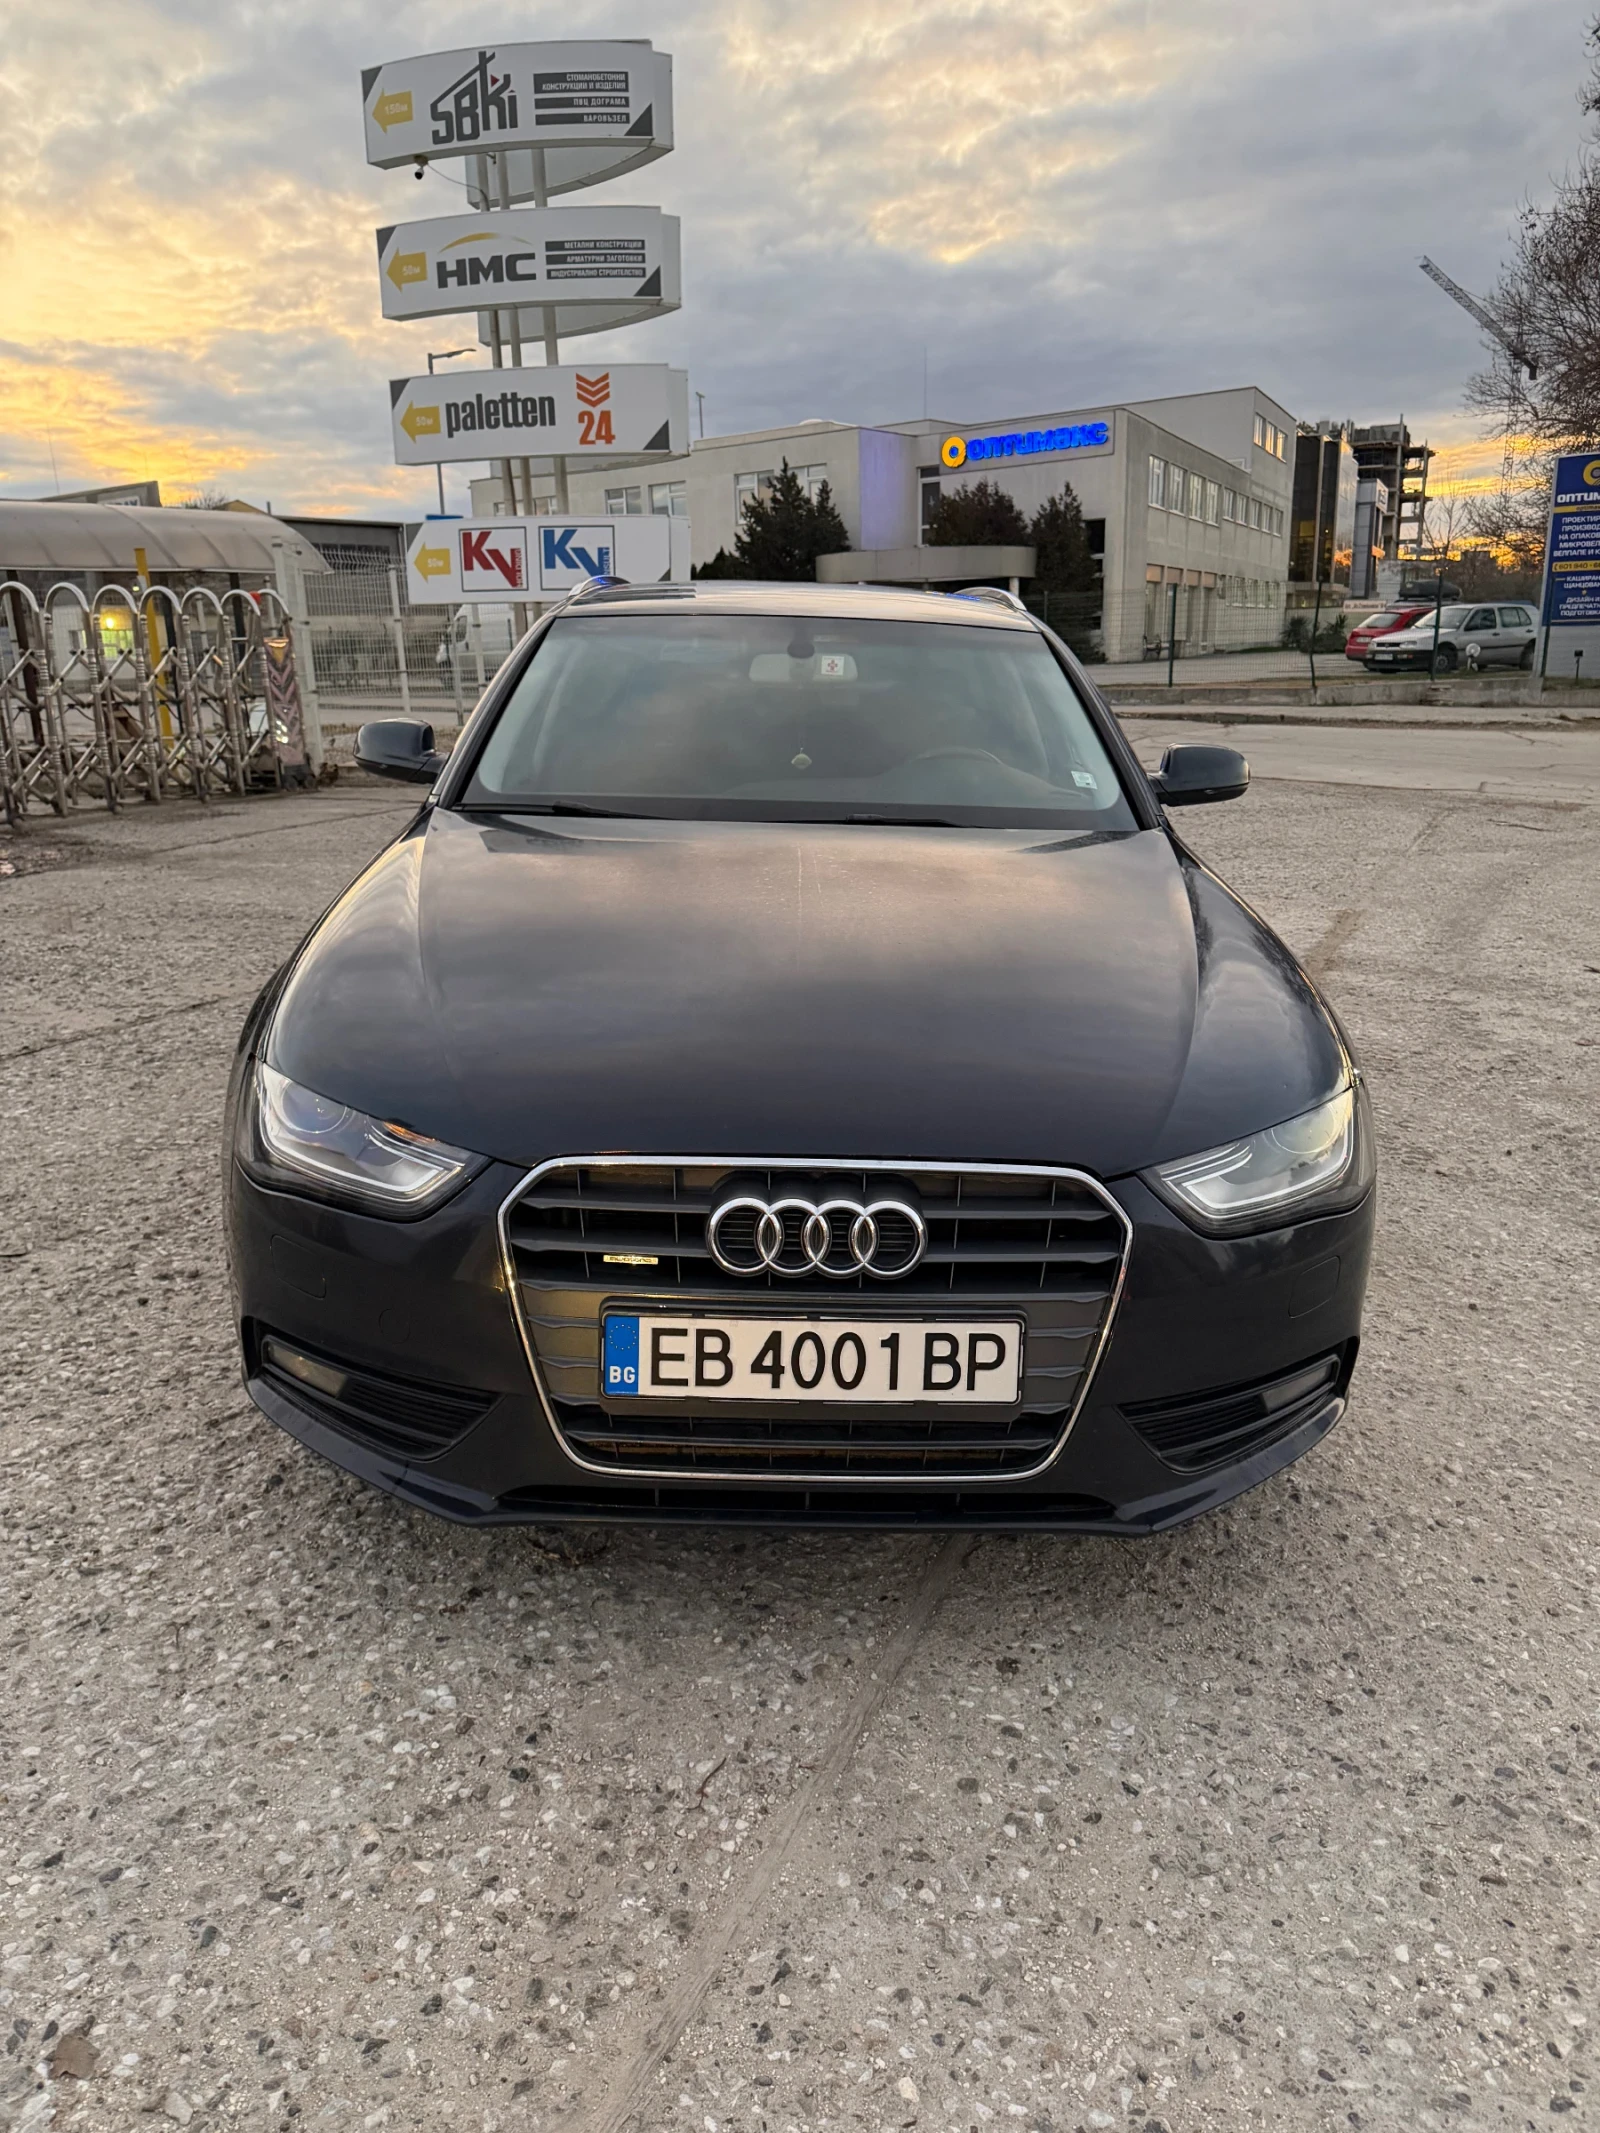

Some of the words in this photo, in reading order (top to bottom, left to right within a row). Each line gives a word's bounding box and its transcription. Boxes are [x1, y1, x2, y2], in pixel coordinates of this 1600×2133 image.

[590, 98, 626, 106] ДОГРАМА
[445, 392, 556, 438] paletten
[578, 410, 615, 445] 24
[609, 1366, 636, 1385] BG
[650, 1328, 734, 1387] EB
[750, 1330, 901, 1391] 4001
[923, 1332, 1006, 1391] BP
